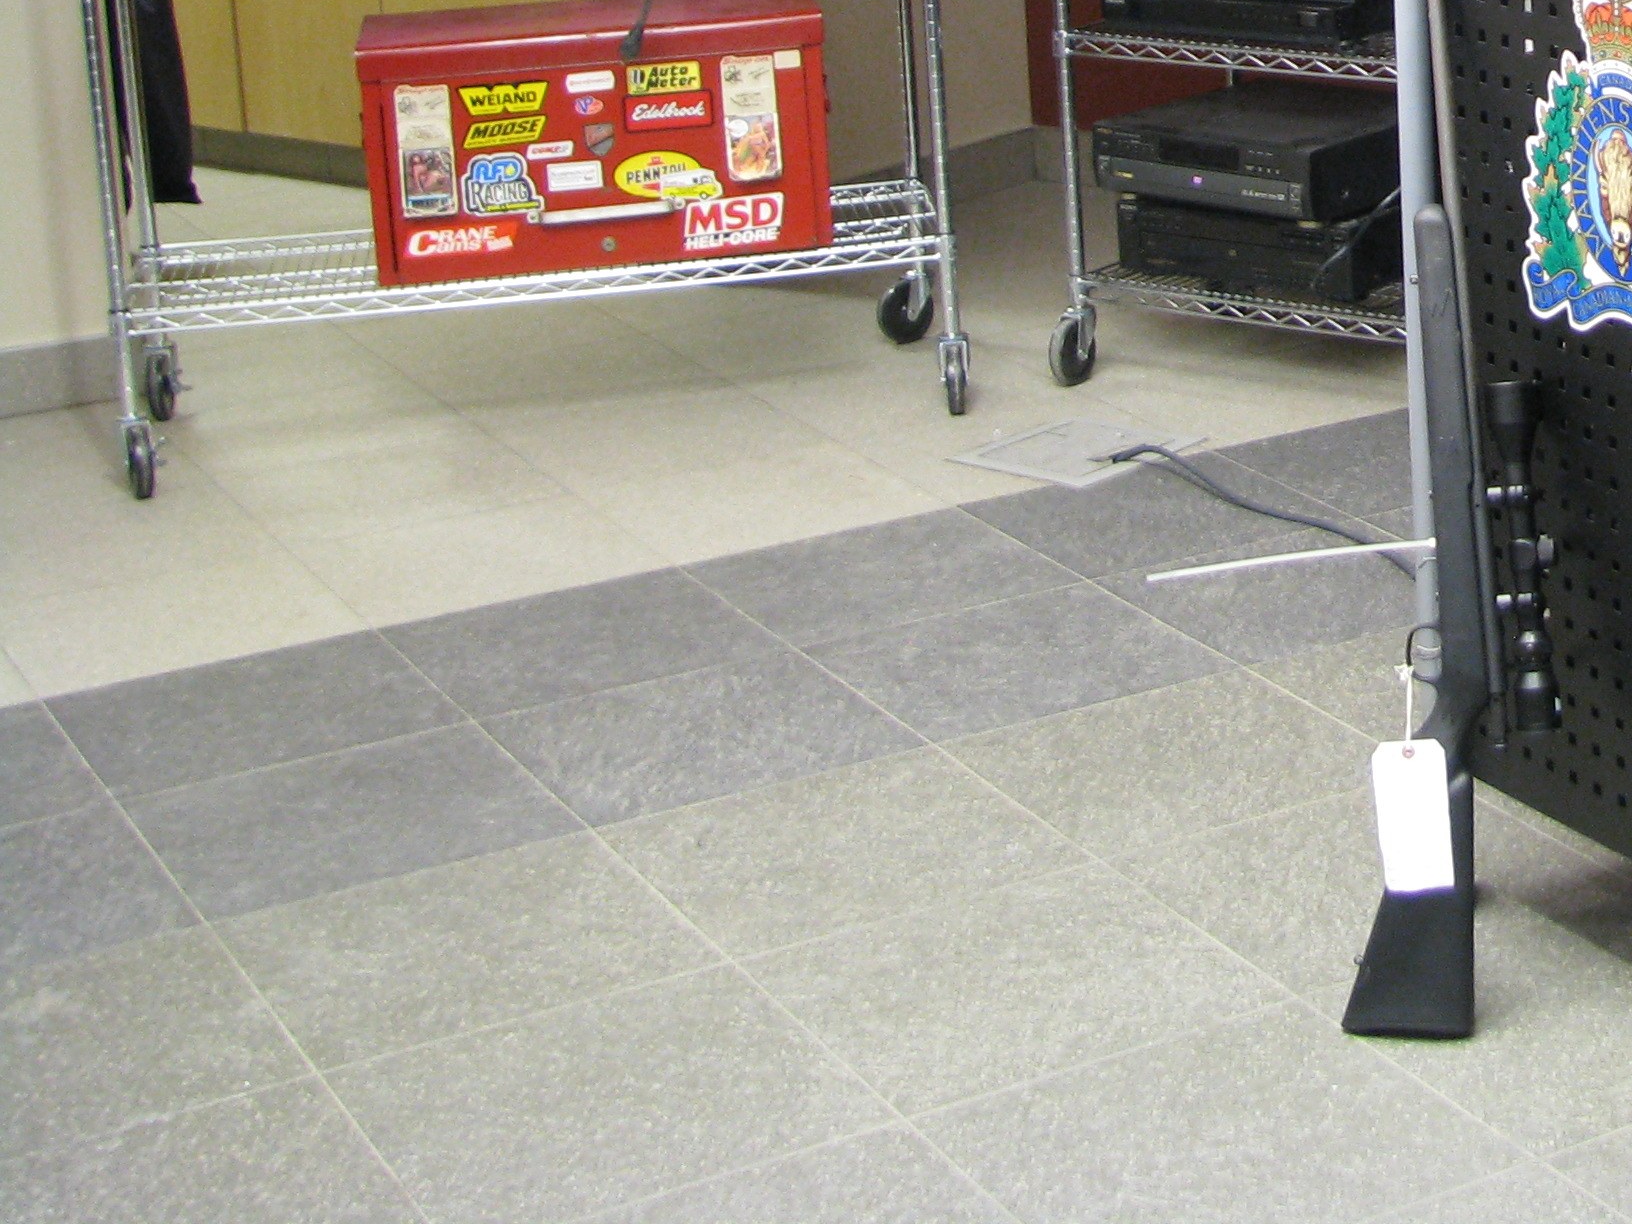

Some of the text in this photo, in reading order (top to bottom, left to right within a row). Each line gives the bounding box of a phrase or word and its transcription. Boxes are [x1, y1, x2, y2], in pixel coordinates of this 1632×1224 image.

[650, 65, 688, 77] Auto
[647, 75, 696, 88] Meter
[469, 91, 536, 107] WEIAND
[632, 101, 705, 121] Edelbrock
[471, 119, 538, 139] MOOSE
[469, 179, 529, 210] RACING
[688, 197, 778, 235] MSD
